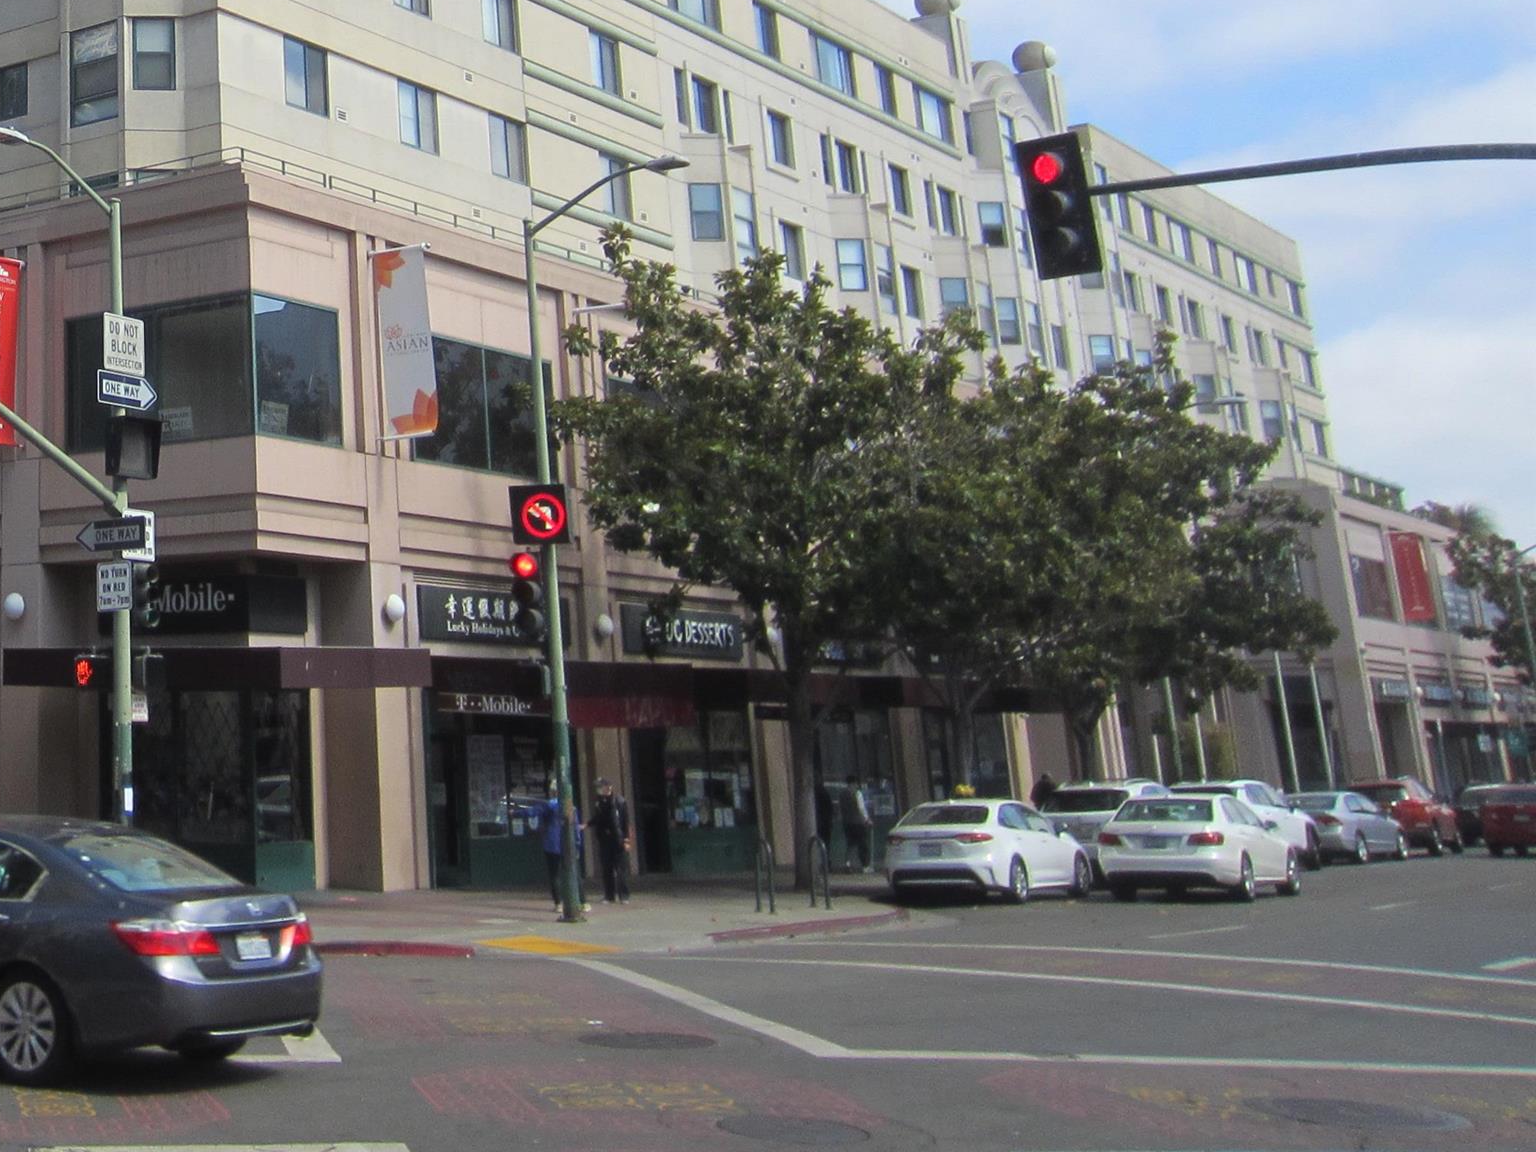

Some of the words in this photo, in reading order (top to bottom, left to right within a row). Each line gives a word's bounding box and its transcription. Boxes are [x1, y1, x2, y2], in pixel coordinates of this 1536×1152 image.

[109, 320, 120, 335] DO
[124, 323, 139, 339] NOT
[111, 339, 138, 356] BLOCK
[387, 336, 428, 352] ASIAN
[106, 355, 142, 370] INTERSECTION
[105, 382, 121, 395] ONE
[123, 385, 140, 398] WAY
[95, 530, 114, 542] ONE
[117, 527, 138, 541] WAY
[100, 568, 109, 579] NO
[111, 566, 128, 578] TURN
[102, 583, 112, 593] ON
[114, 582, 126, 592] RED
[447, 620, 469, 636] Lucky
[471, 622, 504, 638] Holidays
[685, 620, 734, 647] DESSERTS
